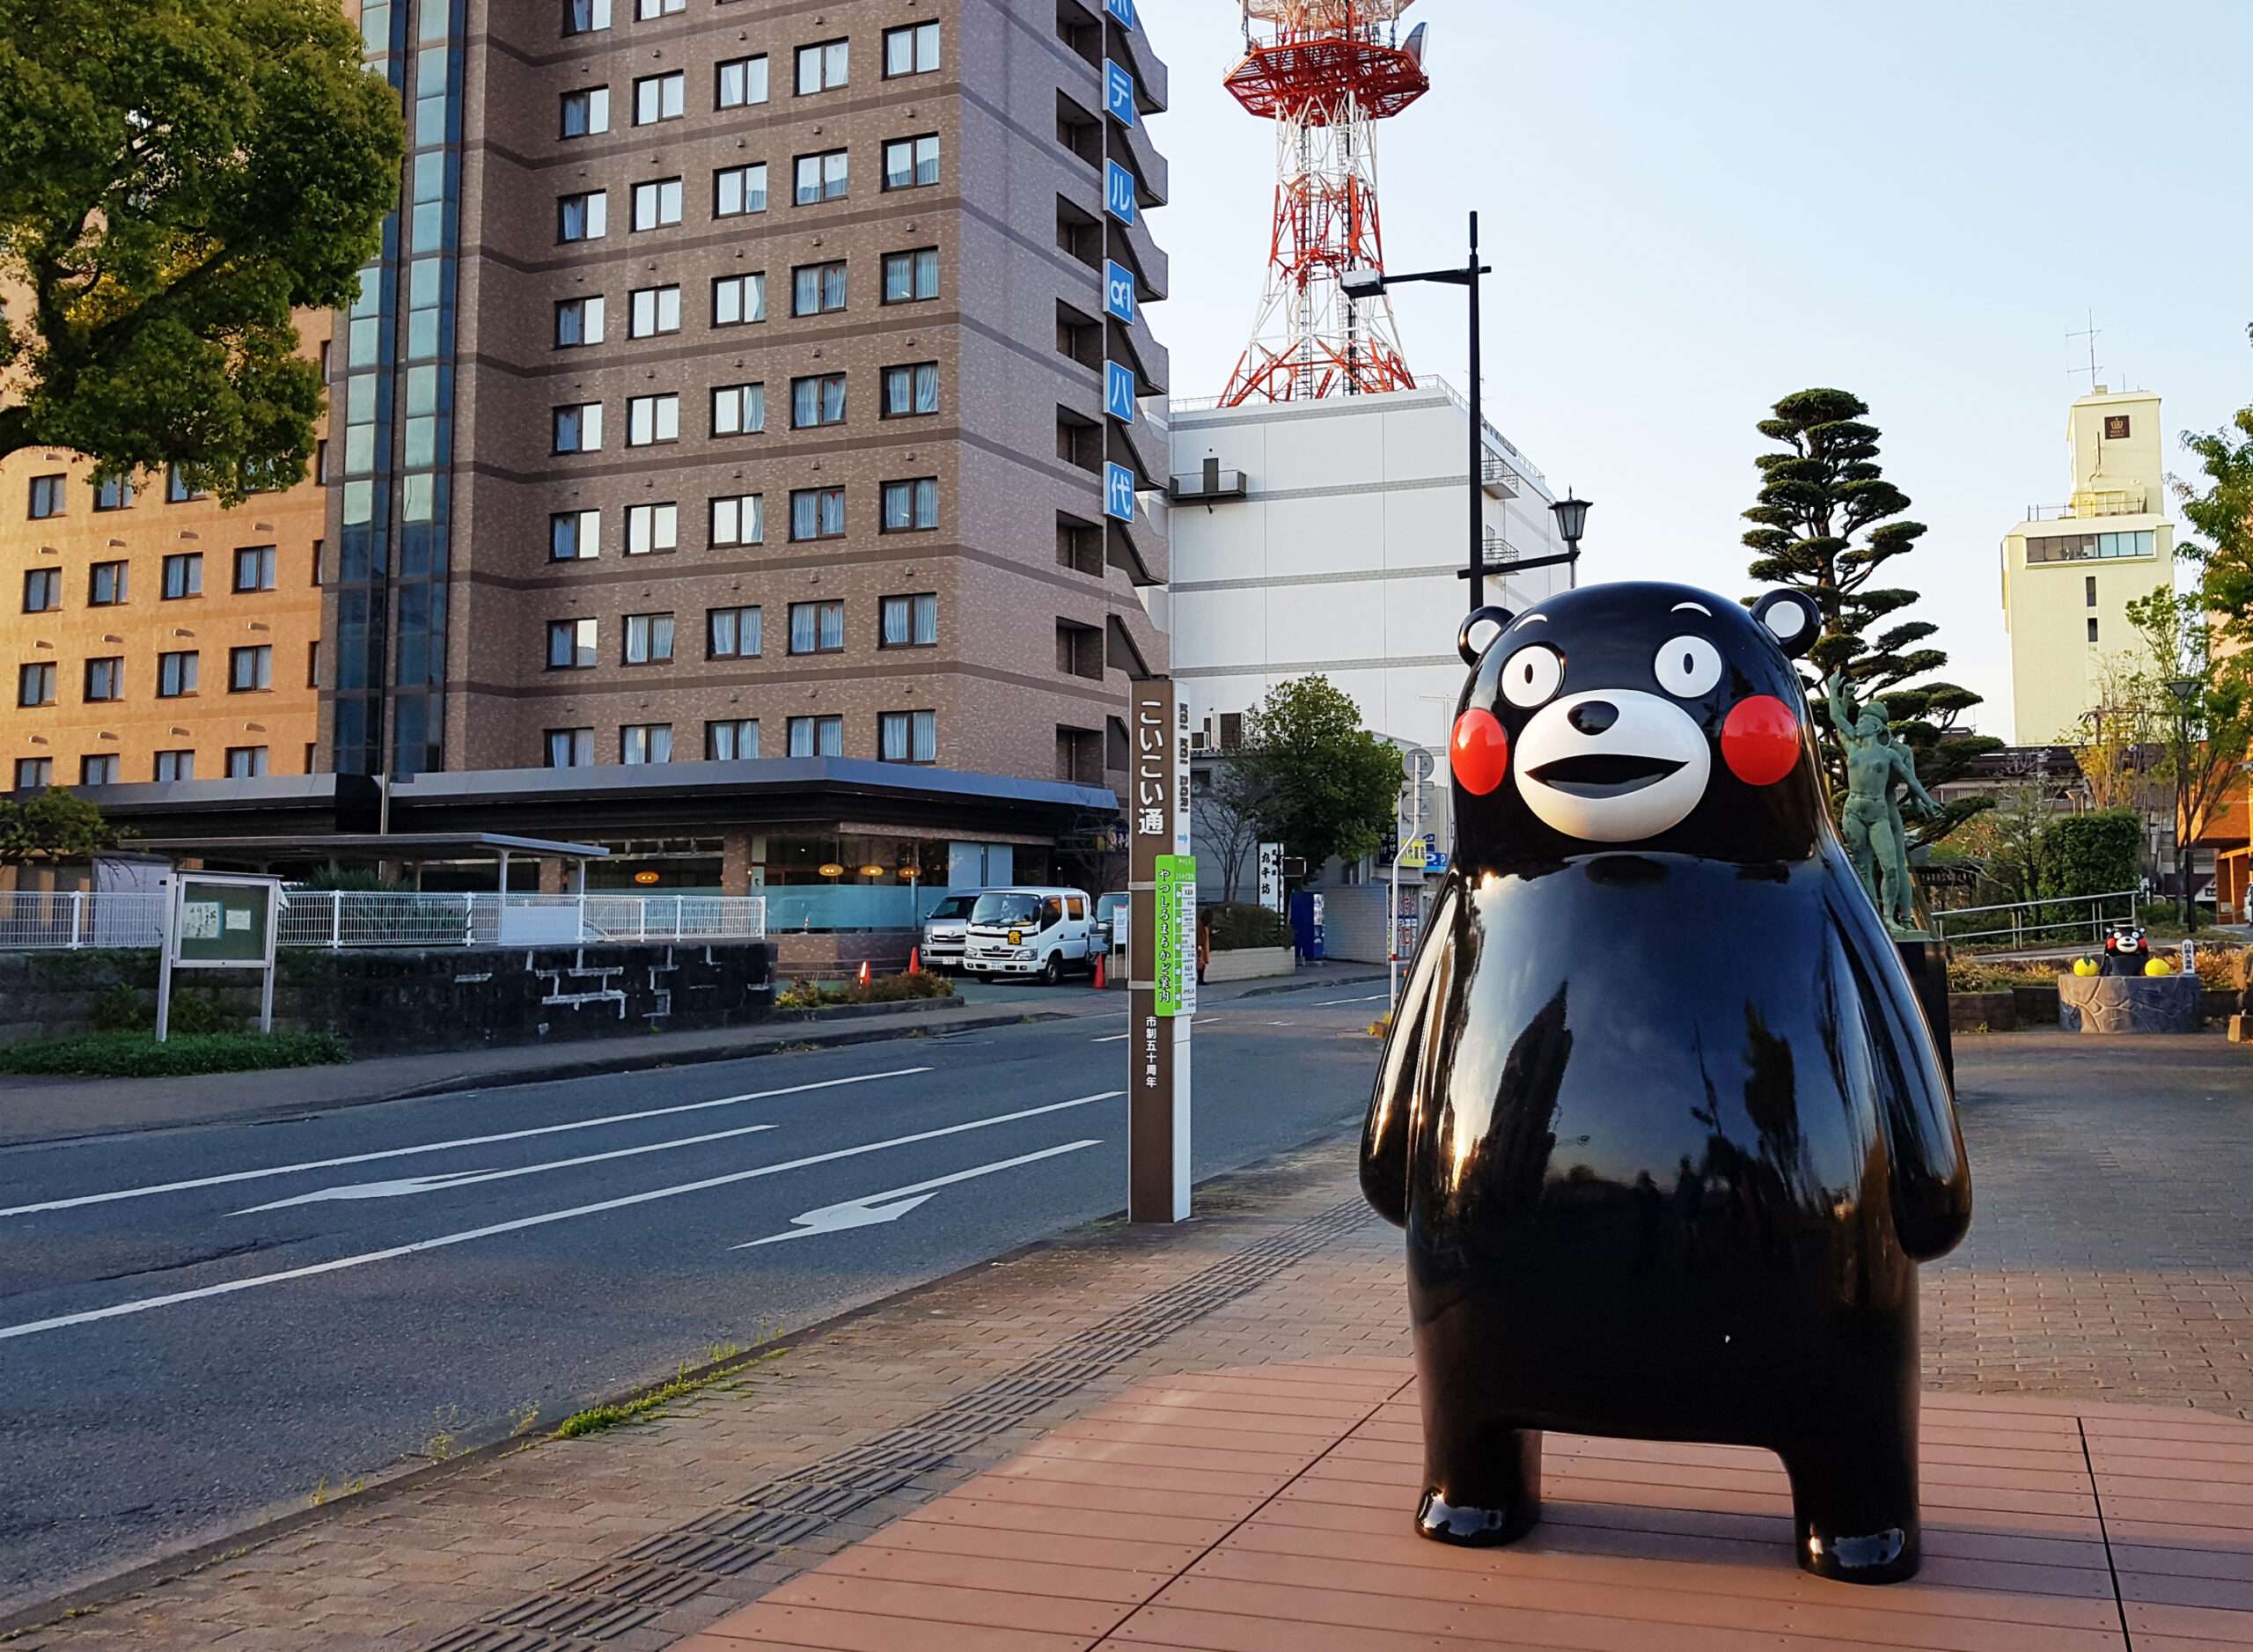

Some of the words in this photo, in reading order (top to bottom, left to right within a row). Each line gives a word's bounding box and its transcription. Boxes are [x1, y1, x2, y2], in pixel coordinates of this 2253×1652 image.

[1178, 702, 1189, 730] KOI
[1138, 701, 1163, 835] こいこい通
[1178, 738, 1189, 765] KOI
[1178, 775, 1189, 812] DORI
[1158, 869, 1171, 1002] やつしろまちかど案内
[1146, 1016, 1157, 1089] 市制五十周年
